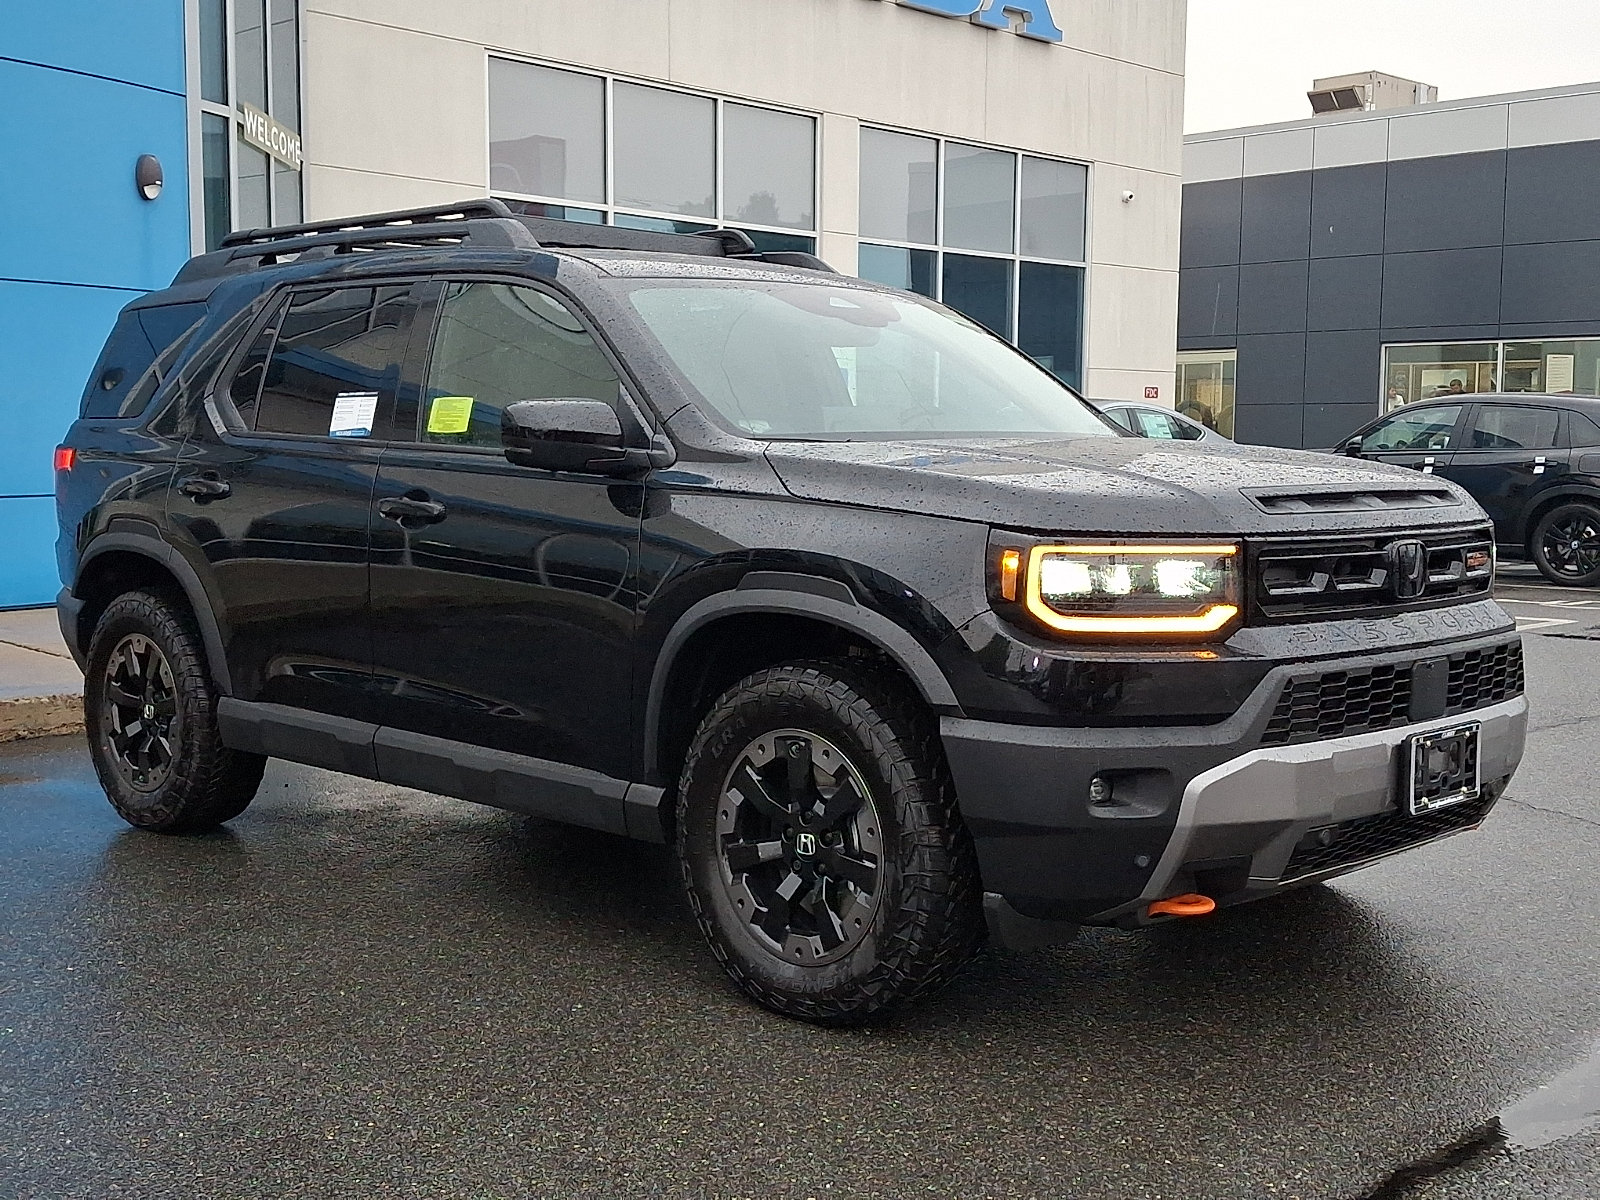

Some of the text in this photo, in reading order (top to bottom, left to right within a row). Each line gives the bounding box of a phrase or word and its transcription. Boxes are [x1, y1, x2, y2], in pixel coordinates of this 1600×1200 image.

[244, 107, 301, 166] WELCOME
[1145, 387, 1158, 398] FDC
[1290, 603, 1497, 651] PASSPORT
